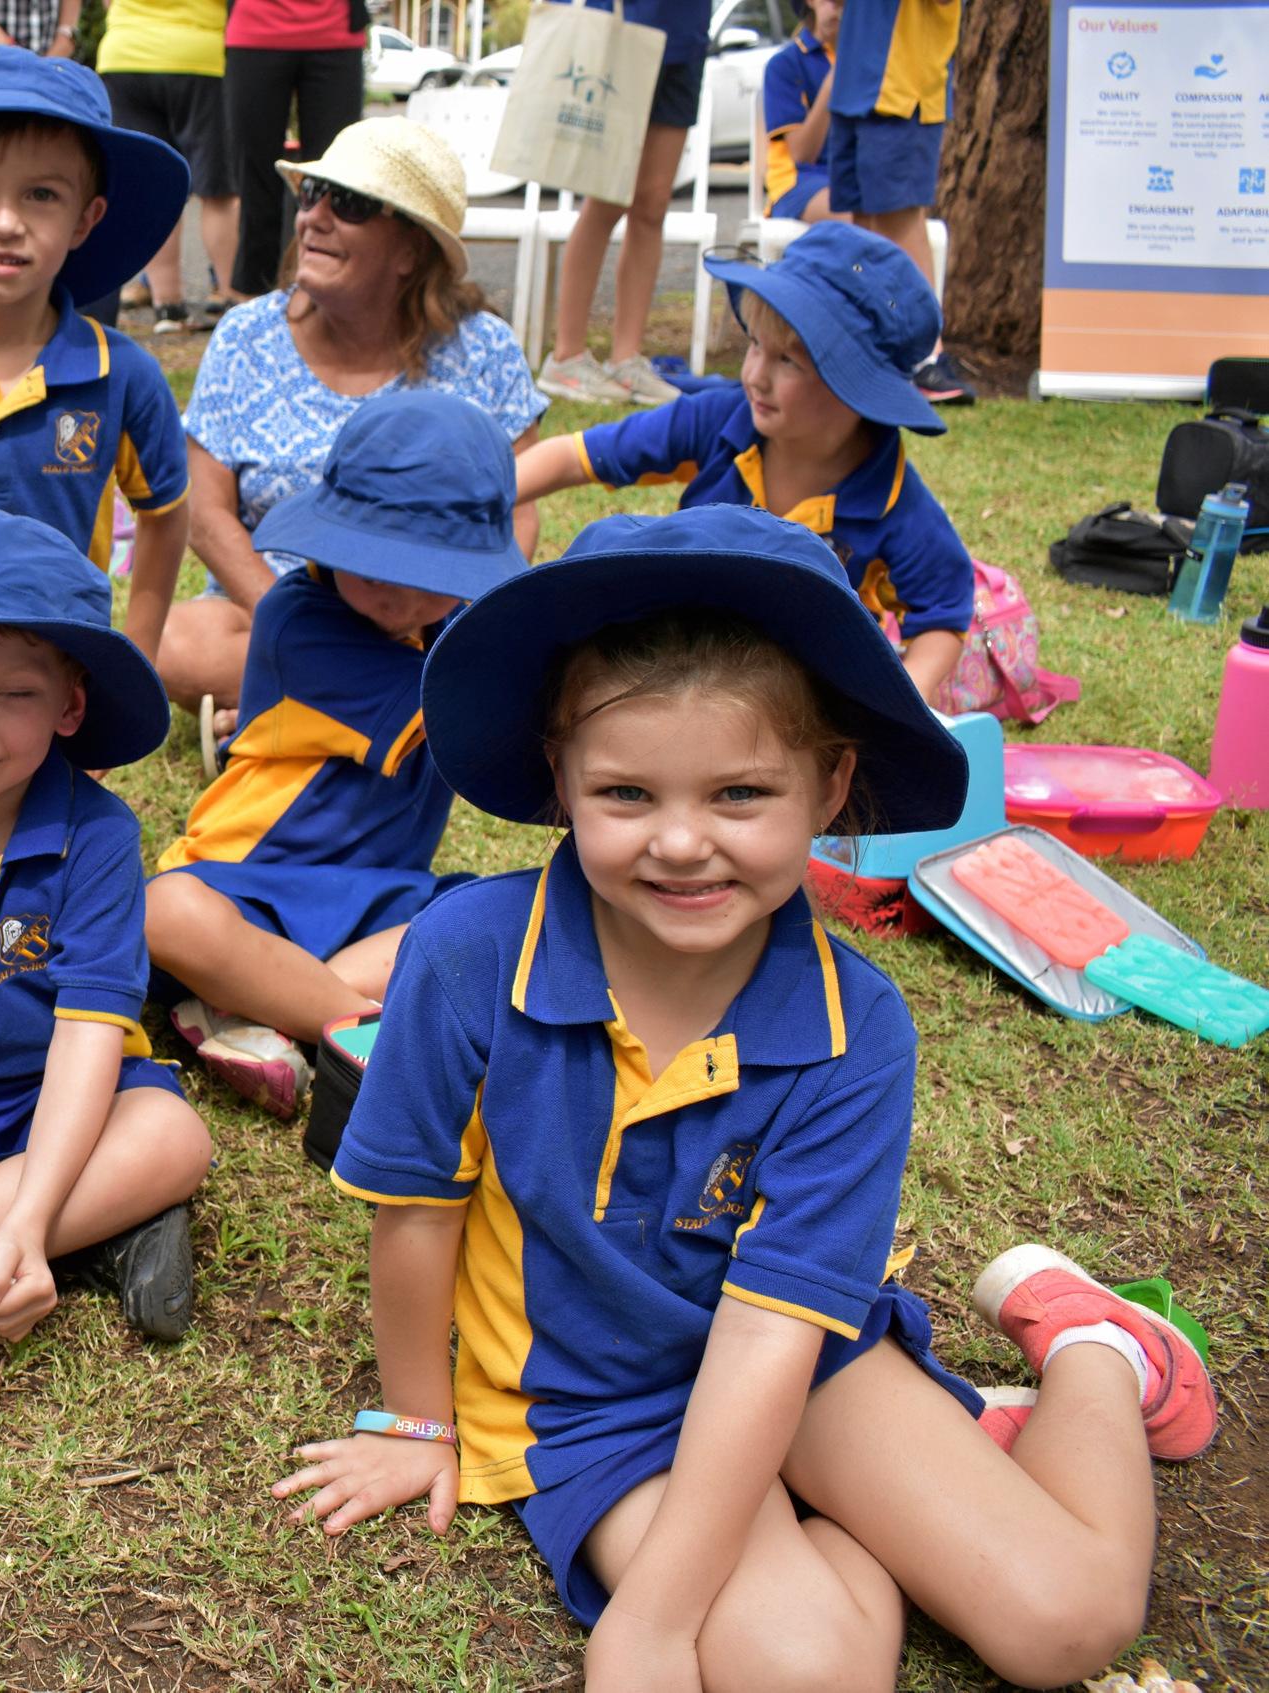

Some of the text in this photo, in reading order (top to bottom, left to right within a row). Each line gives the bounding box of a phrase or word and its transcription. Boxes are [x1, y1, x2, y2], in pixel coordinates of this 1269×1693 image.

[1078, 19, 1159, 34] Our Values
[1099, 91, 1140, 102] QUALITY
[1175, 93, 1243, 103] COMPASSION
[1128, 204, 1194, 216] ENGAGEMENT
[395, 1418, 452, 1438] TOGETHER
